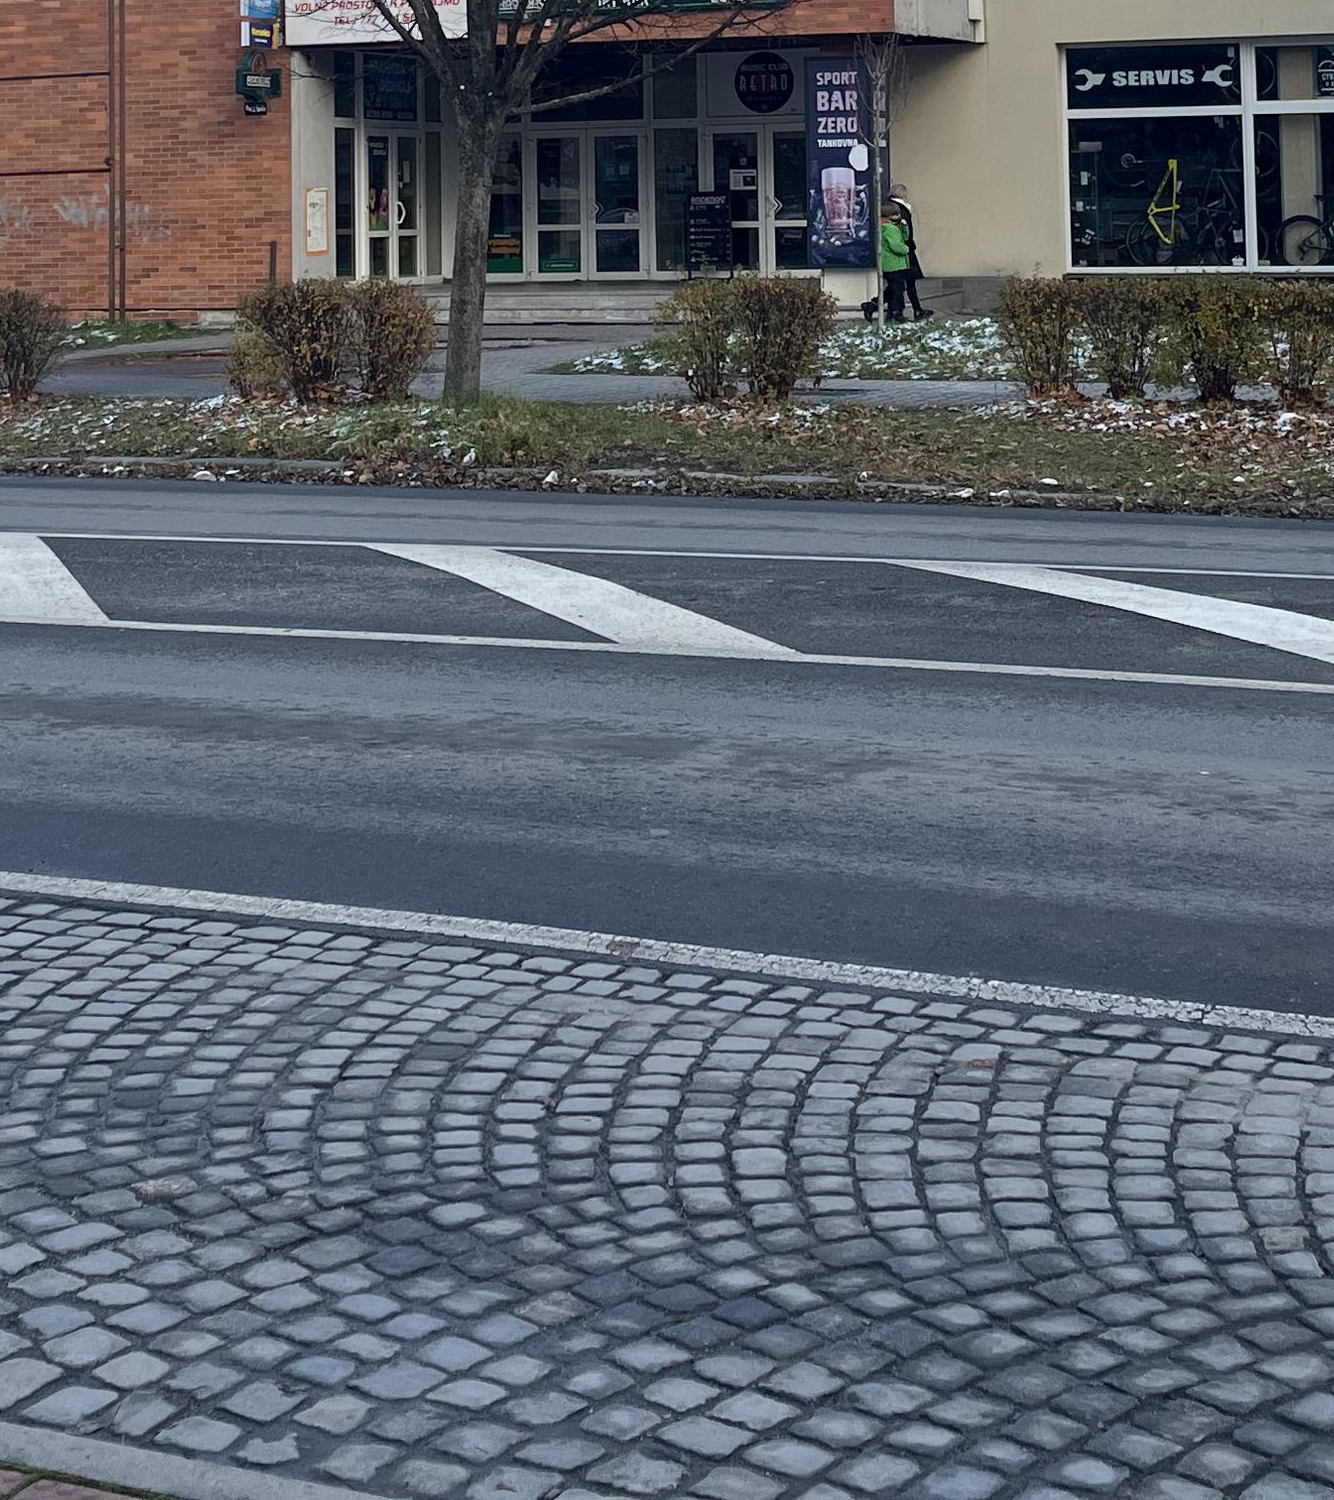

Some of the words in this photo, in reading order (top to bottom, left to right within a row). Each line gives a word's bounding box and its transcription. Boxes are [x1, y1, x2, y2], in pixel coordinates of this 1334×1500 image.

[294, 0, 328, 13] VOLNÉ
[740, 74, 788, 92] RETRO
[816, 71, 858, 86] SPORT
[1112, 68, 1195, 87] SERVIS
[816, 90, 858, 112] BAR
[817, 117, 858, 134] ZERO
[817, 138, 859, 148] TANKOVNA
